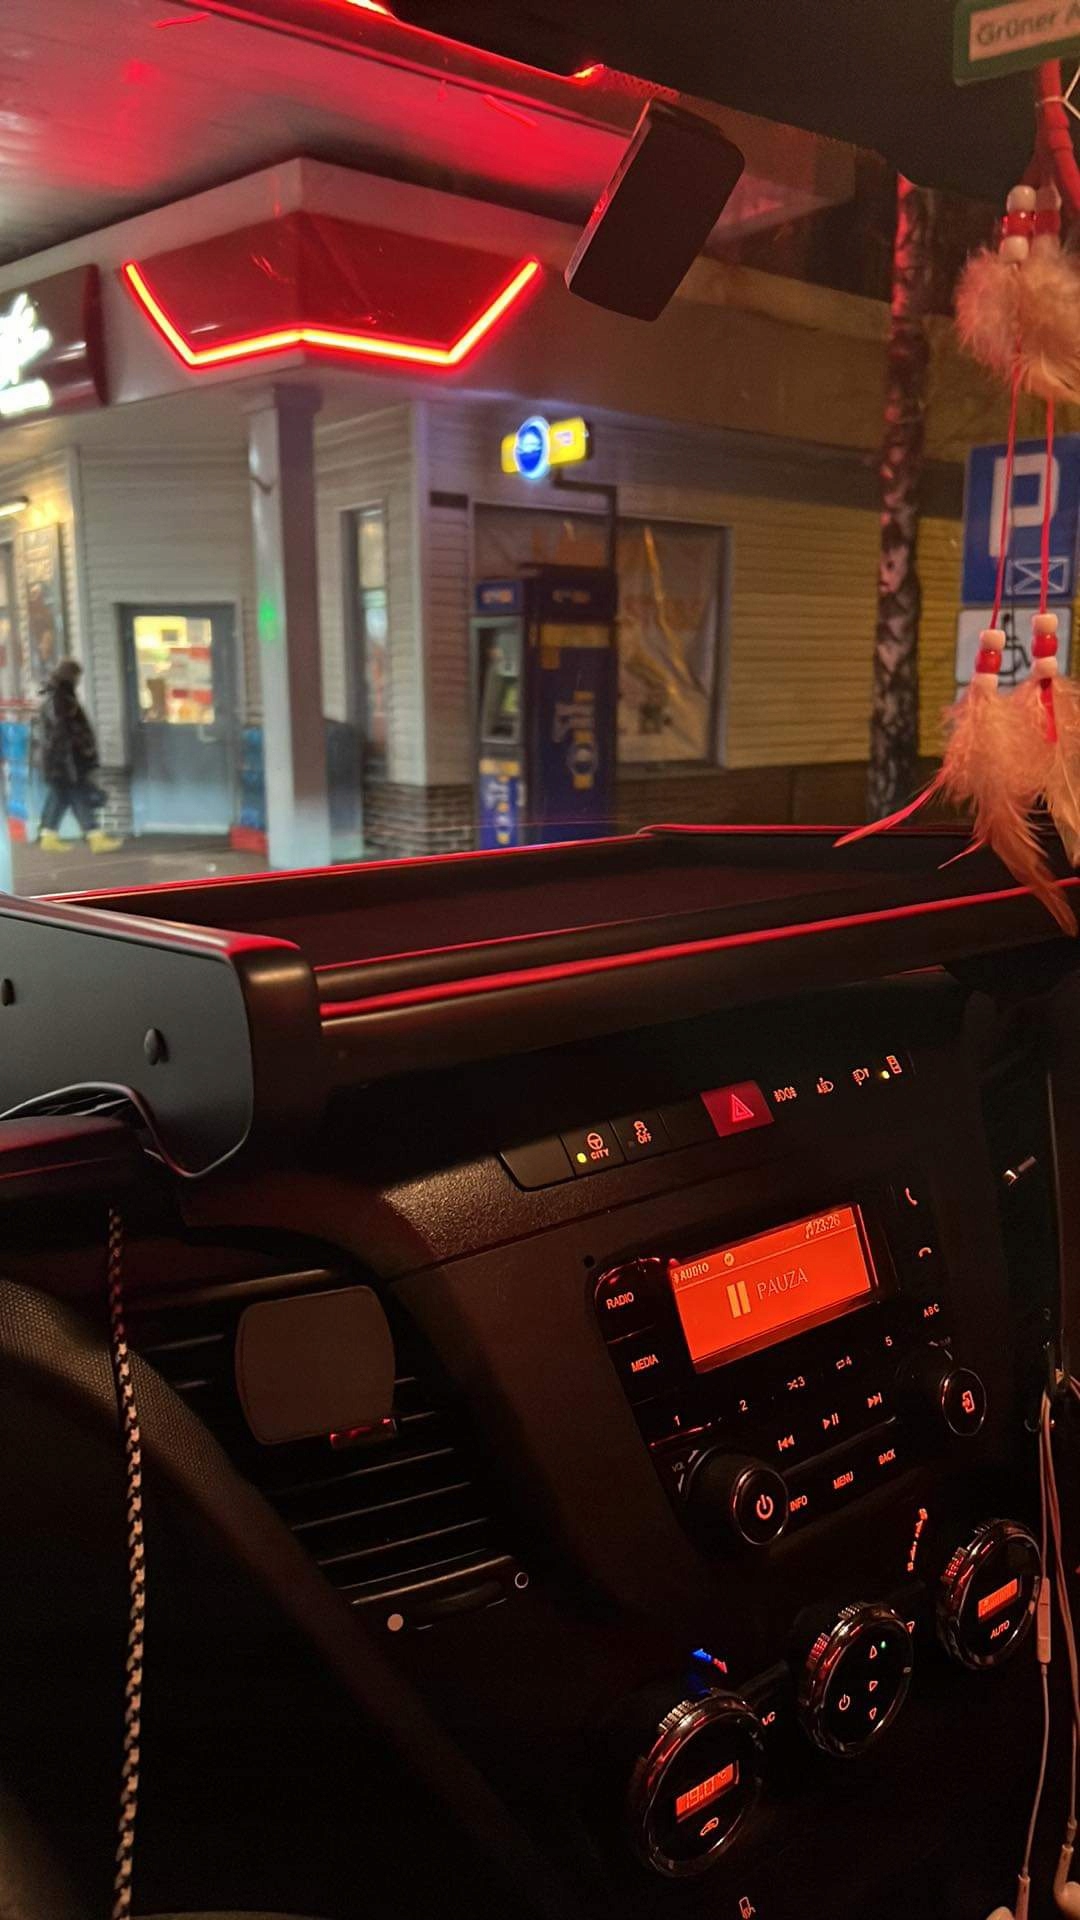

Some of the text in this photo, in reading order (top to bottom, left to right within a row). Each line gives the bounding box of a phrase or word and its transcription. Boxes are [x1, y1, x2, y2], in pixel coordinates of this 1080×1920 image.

[977, 11, 1057, 47] Grüner
[988, 453, 1060, 558] P
[637, 1132, 652, 1145] OFF
[590, 1148, 609, 1160] CITY
[680, 1213, 841, 1281] AUDIO 23:26
[756, 1267, 809, 1300] PAUZA
[606, 1292, 635, 1310] RADIO
[923, 1303, 940, 1318] ABC
[885, 1335, 893, 1347] 5
[631, 1354, 659, 1373] MEDIA
[797, 1375, 806, 1387] 3
[739, 1399, 749, 1412] 2
[673, 1415, 681, 1427] 1
[878, 1448, 896, 1465] BACK
[833, 1471, 854, 1489] MENU
[790, 1495, 808, 1512] INFO
[990, 1620, 1010, 1640] AUTO
